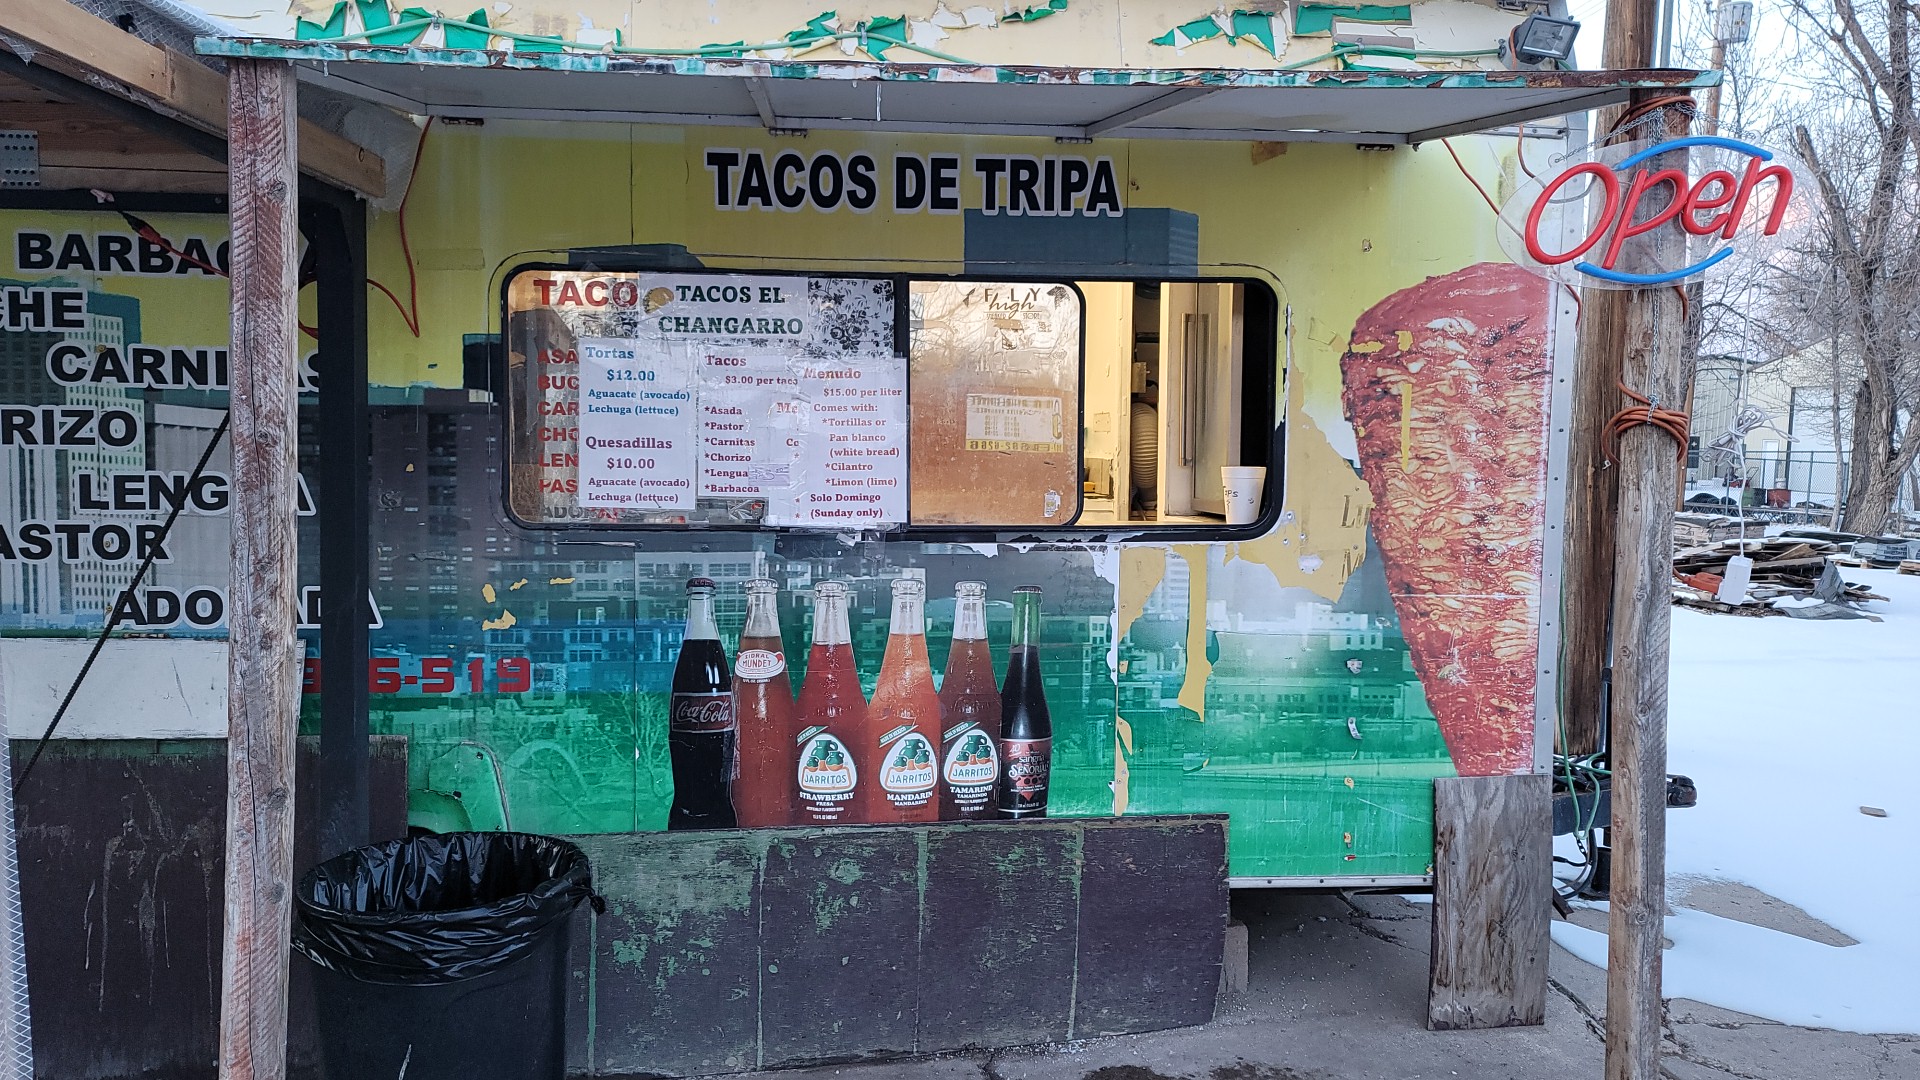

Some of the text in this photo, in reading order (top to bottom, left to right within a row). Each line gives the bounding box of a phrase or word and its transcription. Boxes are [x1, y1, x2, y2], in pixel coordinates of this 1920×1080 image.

[706, 152, 1121, 212] TACOS DE TRIPA
[1524, 156, 1794, 270] Open
[533, 279, 639, 308] TACO
[676, 285, 786, 304] TACOS EL
[657, 315, 804, 335] CHANGARRO
[585, 346, 634, 359] Tortas
[704, 354, 747, 367] Tacos
[606, 369, 656, 383] $12.00
[725, 375, 754, 386] $3.00
[756, 377, 774, 388] per
[588, 388, 691, 402] Aguacate (avocado)
[823, 387, 903, 399] $15.00 per liter
[588, 405, 680, 417] Lechuga (lettuce)
[813, 403, 879, 413] Comes with:
[875, 418, 887, 428] or
[585, 436, 673, 450] Quesadillas
[829, 433, 887, 443] Pan blanco
[829, 447, 901, 459] (white bread)
[606, 458, 656, 471] $10.00
[588, 477, 691, 489] Aguacate (avocado)
[867, 477, 899, 489] (lime)
[588, 492, 680, 504] Lechuga (lettuce)
[810, 493, 882, 505] Solo Domingo
[810, 507, 884, 520] (Sunday only)
[742, 659, 773, 669] MUNDET
[676, 700, 731, 723] Coca-Cola
[889, 772, 932, 784] JARRITOS
[952, 766, 993, 778] JARRITOS
[804, 774, 847, 785] JARRITOS
[949, 784, 993, 794] TAMARIND
[799, 791, 854, 801] STRAWBERRY
[887, 791, 933, 802] MANDARIN
[894, 799, 928, 807] MANDARINA
